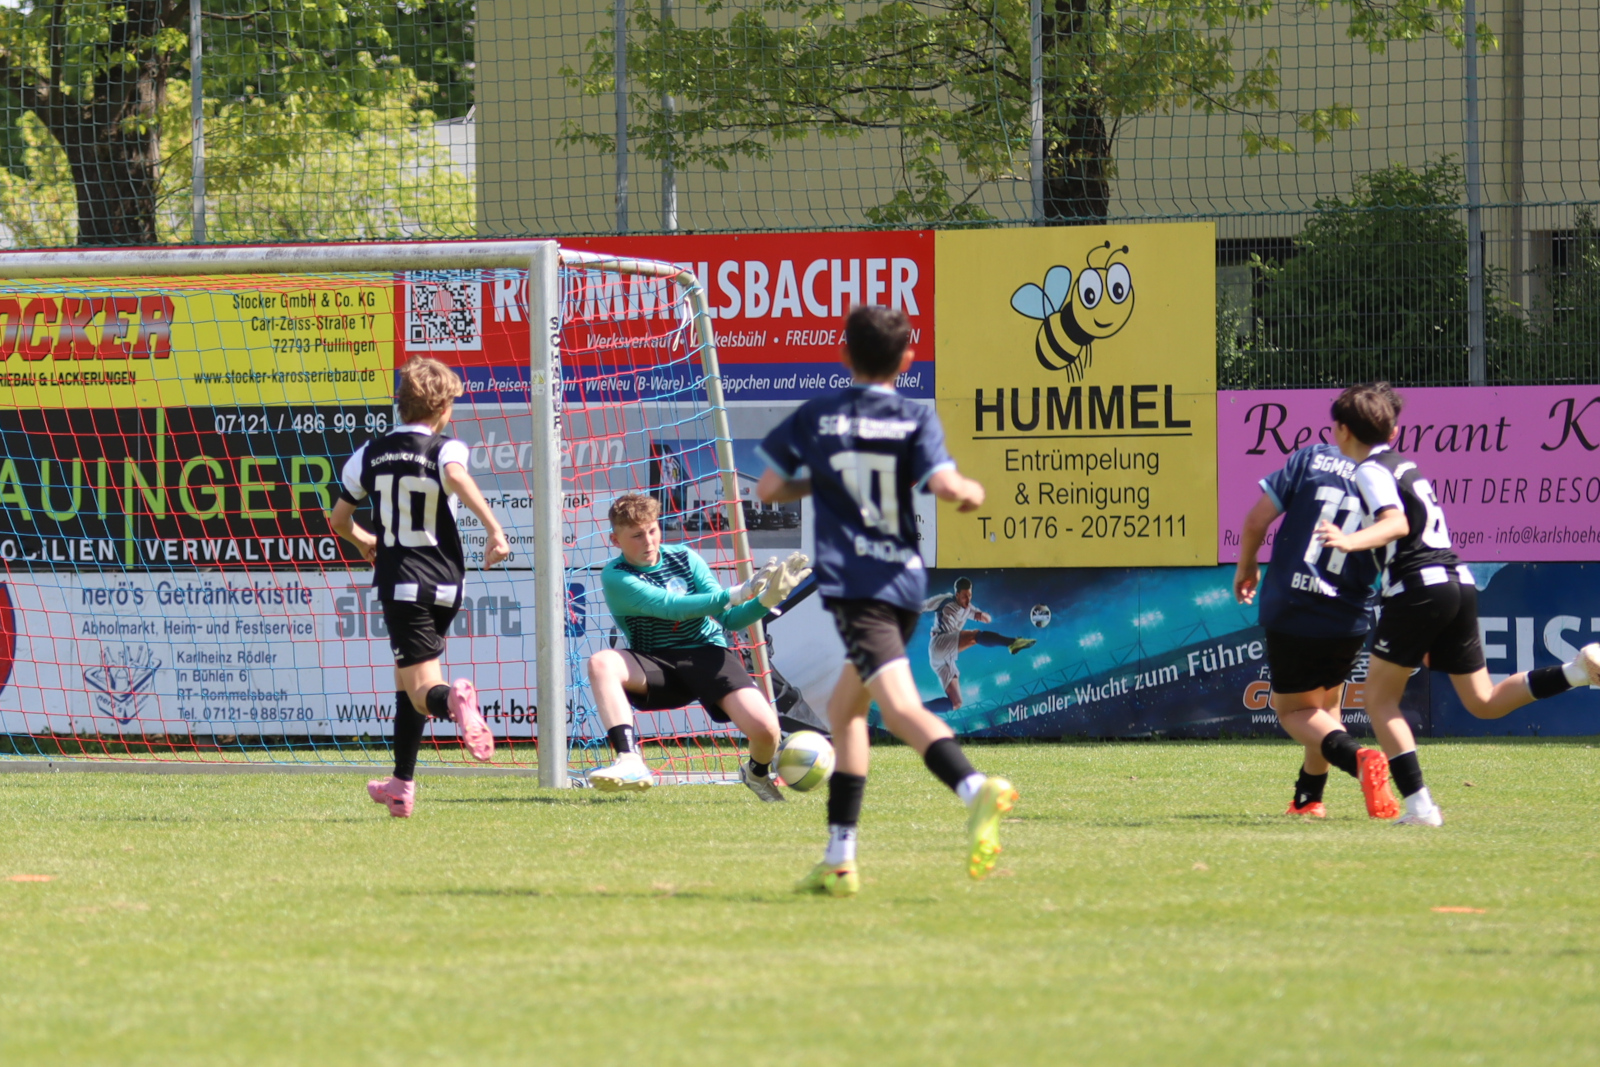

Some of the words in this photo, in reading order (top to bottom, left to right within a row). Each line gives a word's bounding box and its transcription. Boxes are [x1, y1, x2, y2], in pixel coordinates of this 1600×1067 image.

[232, 293, 276, 309] Stocker
[280, 292, 316, 308] GmbH
[321, 292, 330, 307] &
[335, 292, 354, 307] Co.
[359, 291, 375, 307] KG
[251, 314, 357, 332] Carl-Zeiss-Straße
[360, 314, 375, 330] 17
[273, 338, 311, 354] 72793
[314, 337, 376, 356] Pfullingen
[691, 330, 767, 349] Dkelsbühl
[786, 329, 836, 346] FREUDE
[39, 372, 48, 386] &
[51, 371, 136, 387] LACKIERUNGEN
[194, 369, 376, 385] www.stocker-karosseriebau.de
[634, 375, 684, 394] (B-Ware)
[694, 373, 771, 393] Scäppchen
[773, 372, 797, 389] und
[798, 371, 826, 389] viele
[974, 384, 1191, 432] HUMMEL
[214, 414, 269, 435] 07121
[291, 413, 326, 434] 486
[333, 413, 357, 433] 99
[364, 412, 388, 433] 96
[1244, 403, 1512, 456] Resurant
[1004, 447, 1160, 476] Entrümpelung
[1014, 482, 1031, 505] &
[1039, 481, 1150, 510] Reinigung
[1481, 478, 1528, 504] DER
[1538, 477, 1600, 504] BESO
[374, 474, 440, 548] 10
[1003, 516, 1058, 540] 0176
[1081, 514, 1187, 539] 20752111
[1, 538, 115, 562] OILIEN
[145, 537, 337, 562] VERWALTUNG
[82, 580, 144, 607] nerö's
[157, 579, 314, 606] Getränkekistle
[82, 620, 160, 637] Abholmarkt,
[164, 619, 204, 636] Heim-
[206, 619, 230, 636] und
[236, 619, 314, 636] Festservice
[177, 650, 233, 664] Karlheinz
[237, 649, 278, 664] Rödler
[192, 667, 234, 683] Bühlen
[239, 669, 248, 682] 6
[1007, 703, 1029, 724] Mit
[1032, 694, 1071, 718] voller
[1073, 676, 1129, 706] Wucht
[1134, 664, 1179, 691] zum
[1186, 640, 1264, 677] Führe
[177, 707, 198, 721] Tel.
